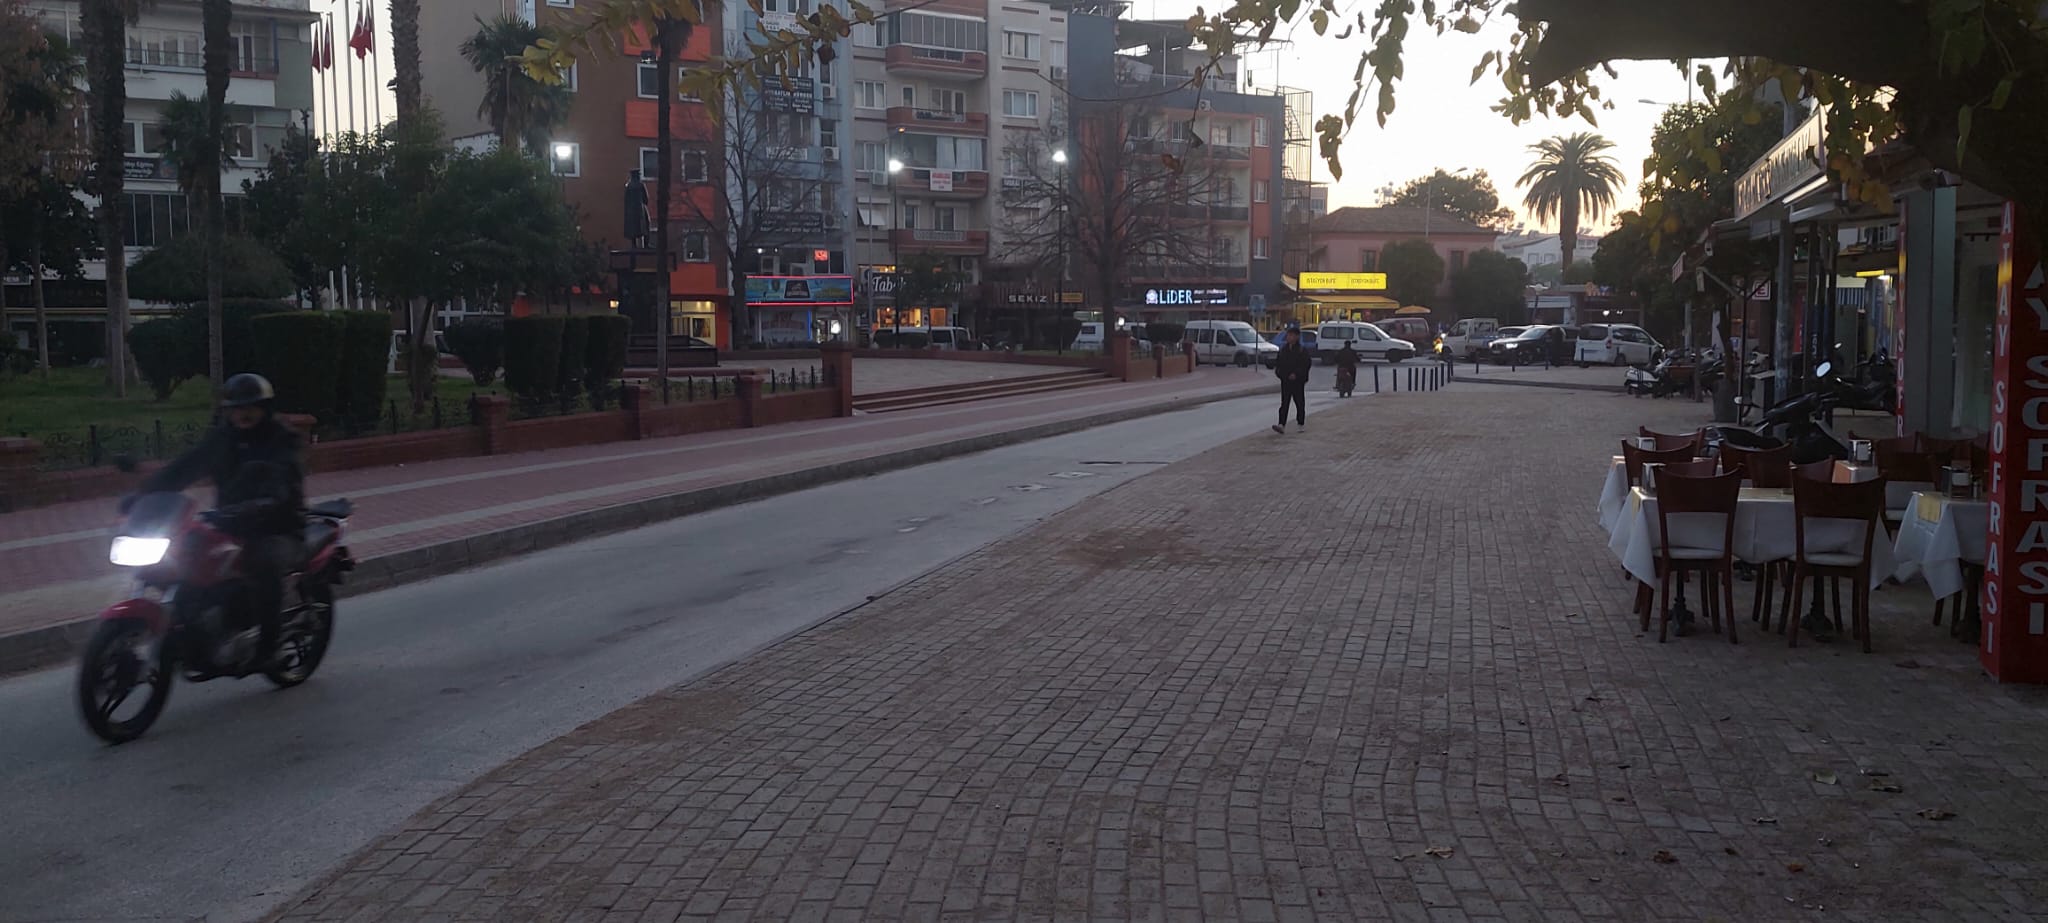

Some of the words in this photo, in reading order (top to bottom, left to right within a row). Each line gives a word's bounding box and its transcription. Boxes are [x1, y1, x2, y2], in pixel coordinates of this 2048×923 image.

[1998, 201, 2012, 357] ATAY
[1897, 328, 1905, 438] SOFR
[1986, 380, 2005, 654] SOFRASI
